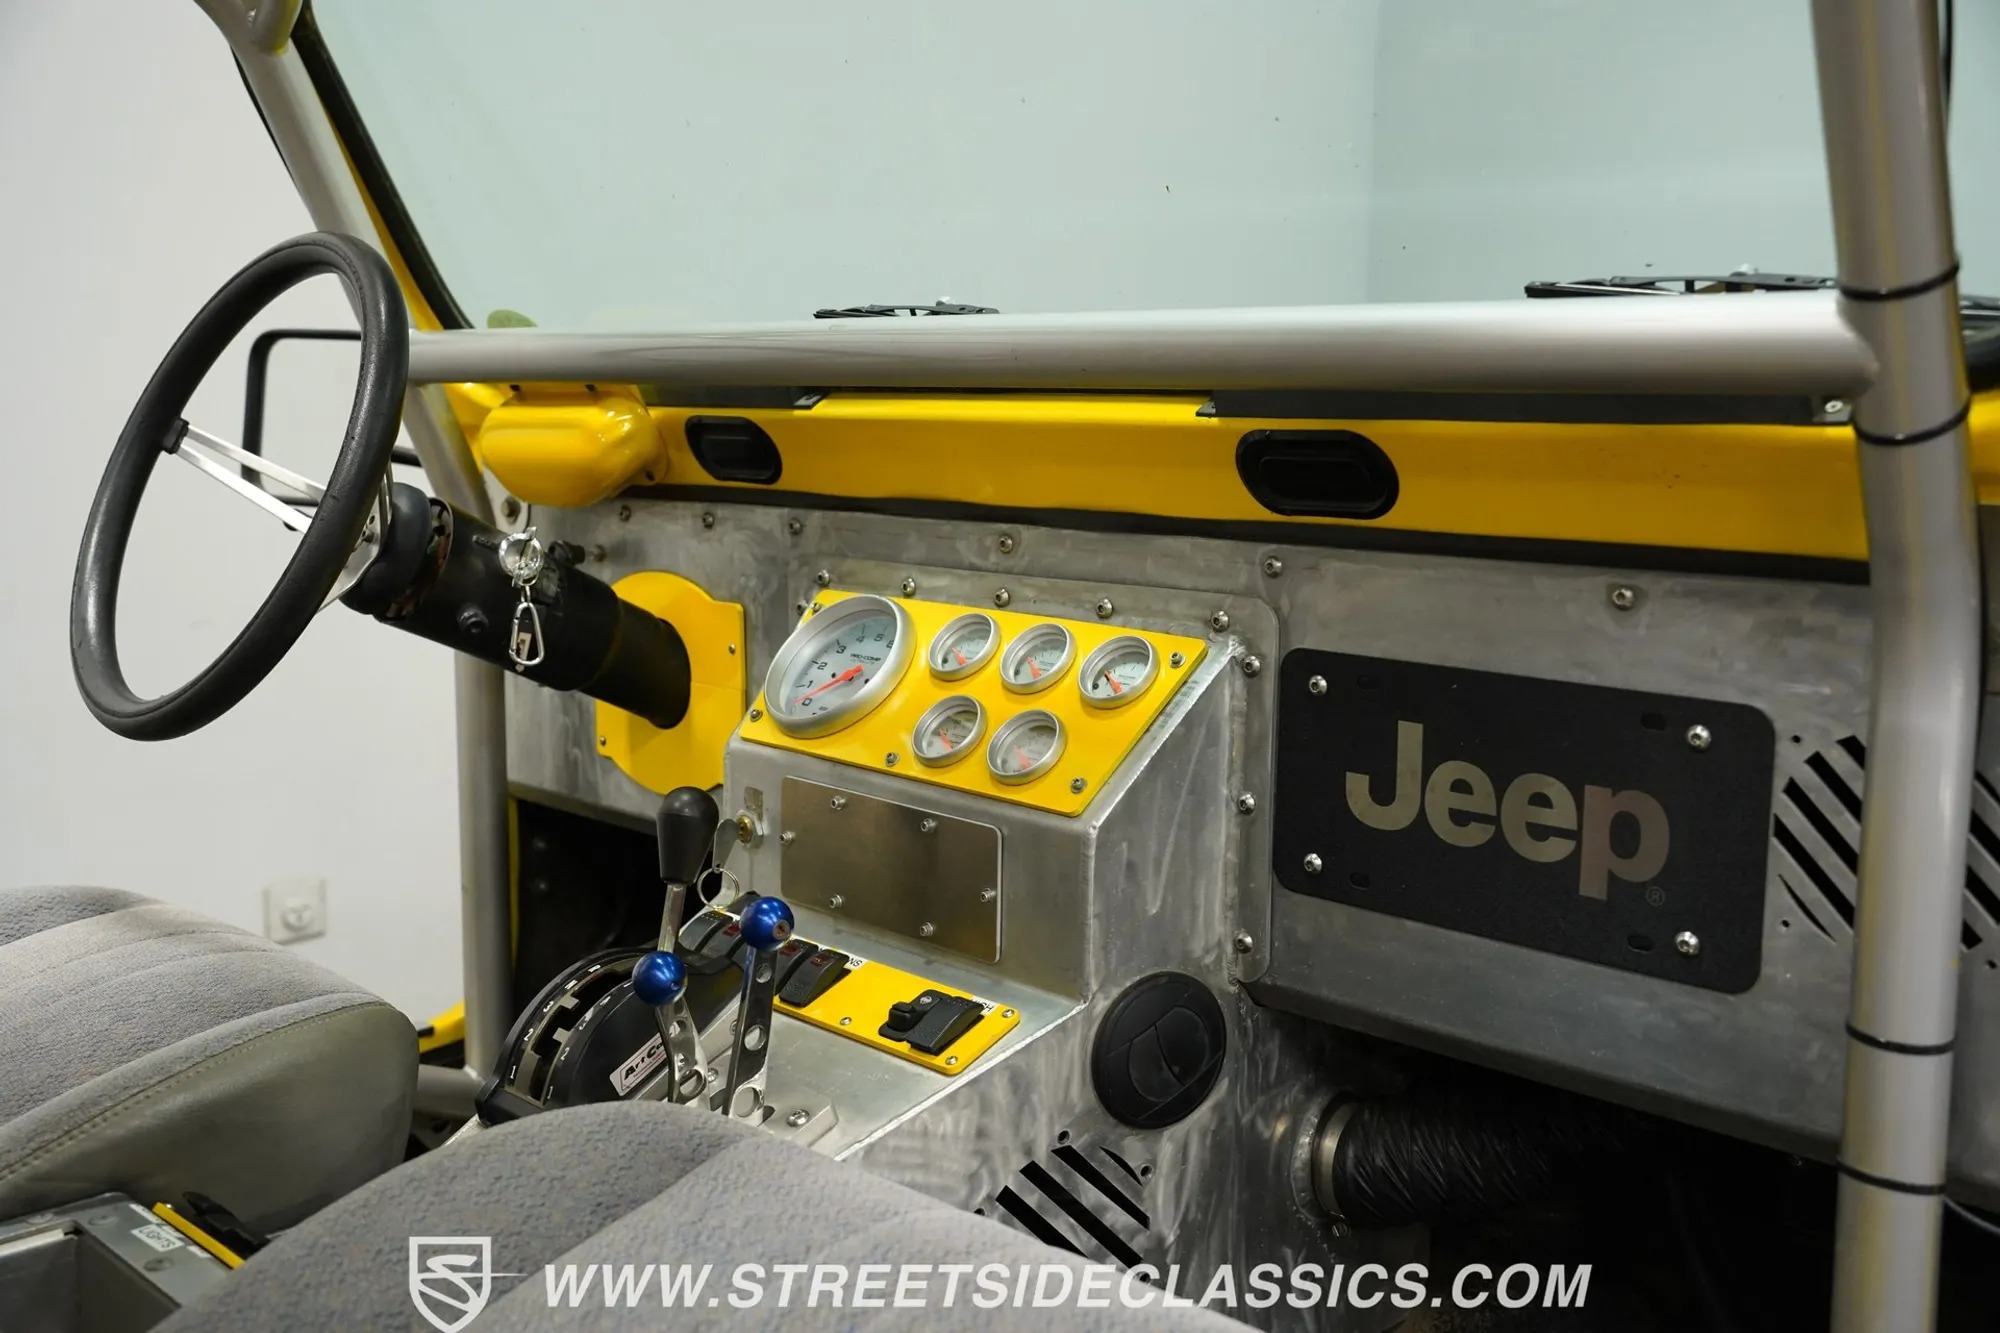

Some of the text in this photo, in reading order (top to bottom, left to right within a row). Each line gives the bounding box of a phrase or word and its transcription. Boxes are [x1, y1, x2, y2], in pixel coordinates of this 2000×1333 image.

[874, 633, 885, 642] 5
[836, 645, 847, 654] 3
[816, 661, 828, 670] 2
[806, 680, 814, 688] 1
[801, 698, 813, 707] 0
[1345, 719, 1671, 901] Jeep
[542, 1000, 554, 1013] 3
[523, 1028, 534, 1041] 2
[560, 1046, 570, 1061] 2
[509, 1065, 517, 1079] 1
